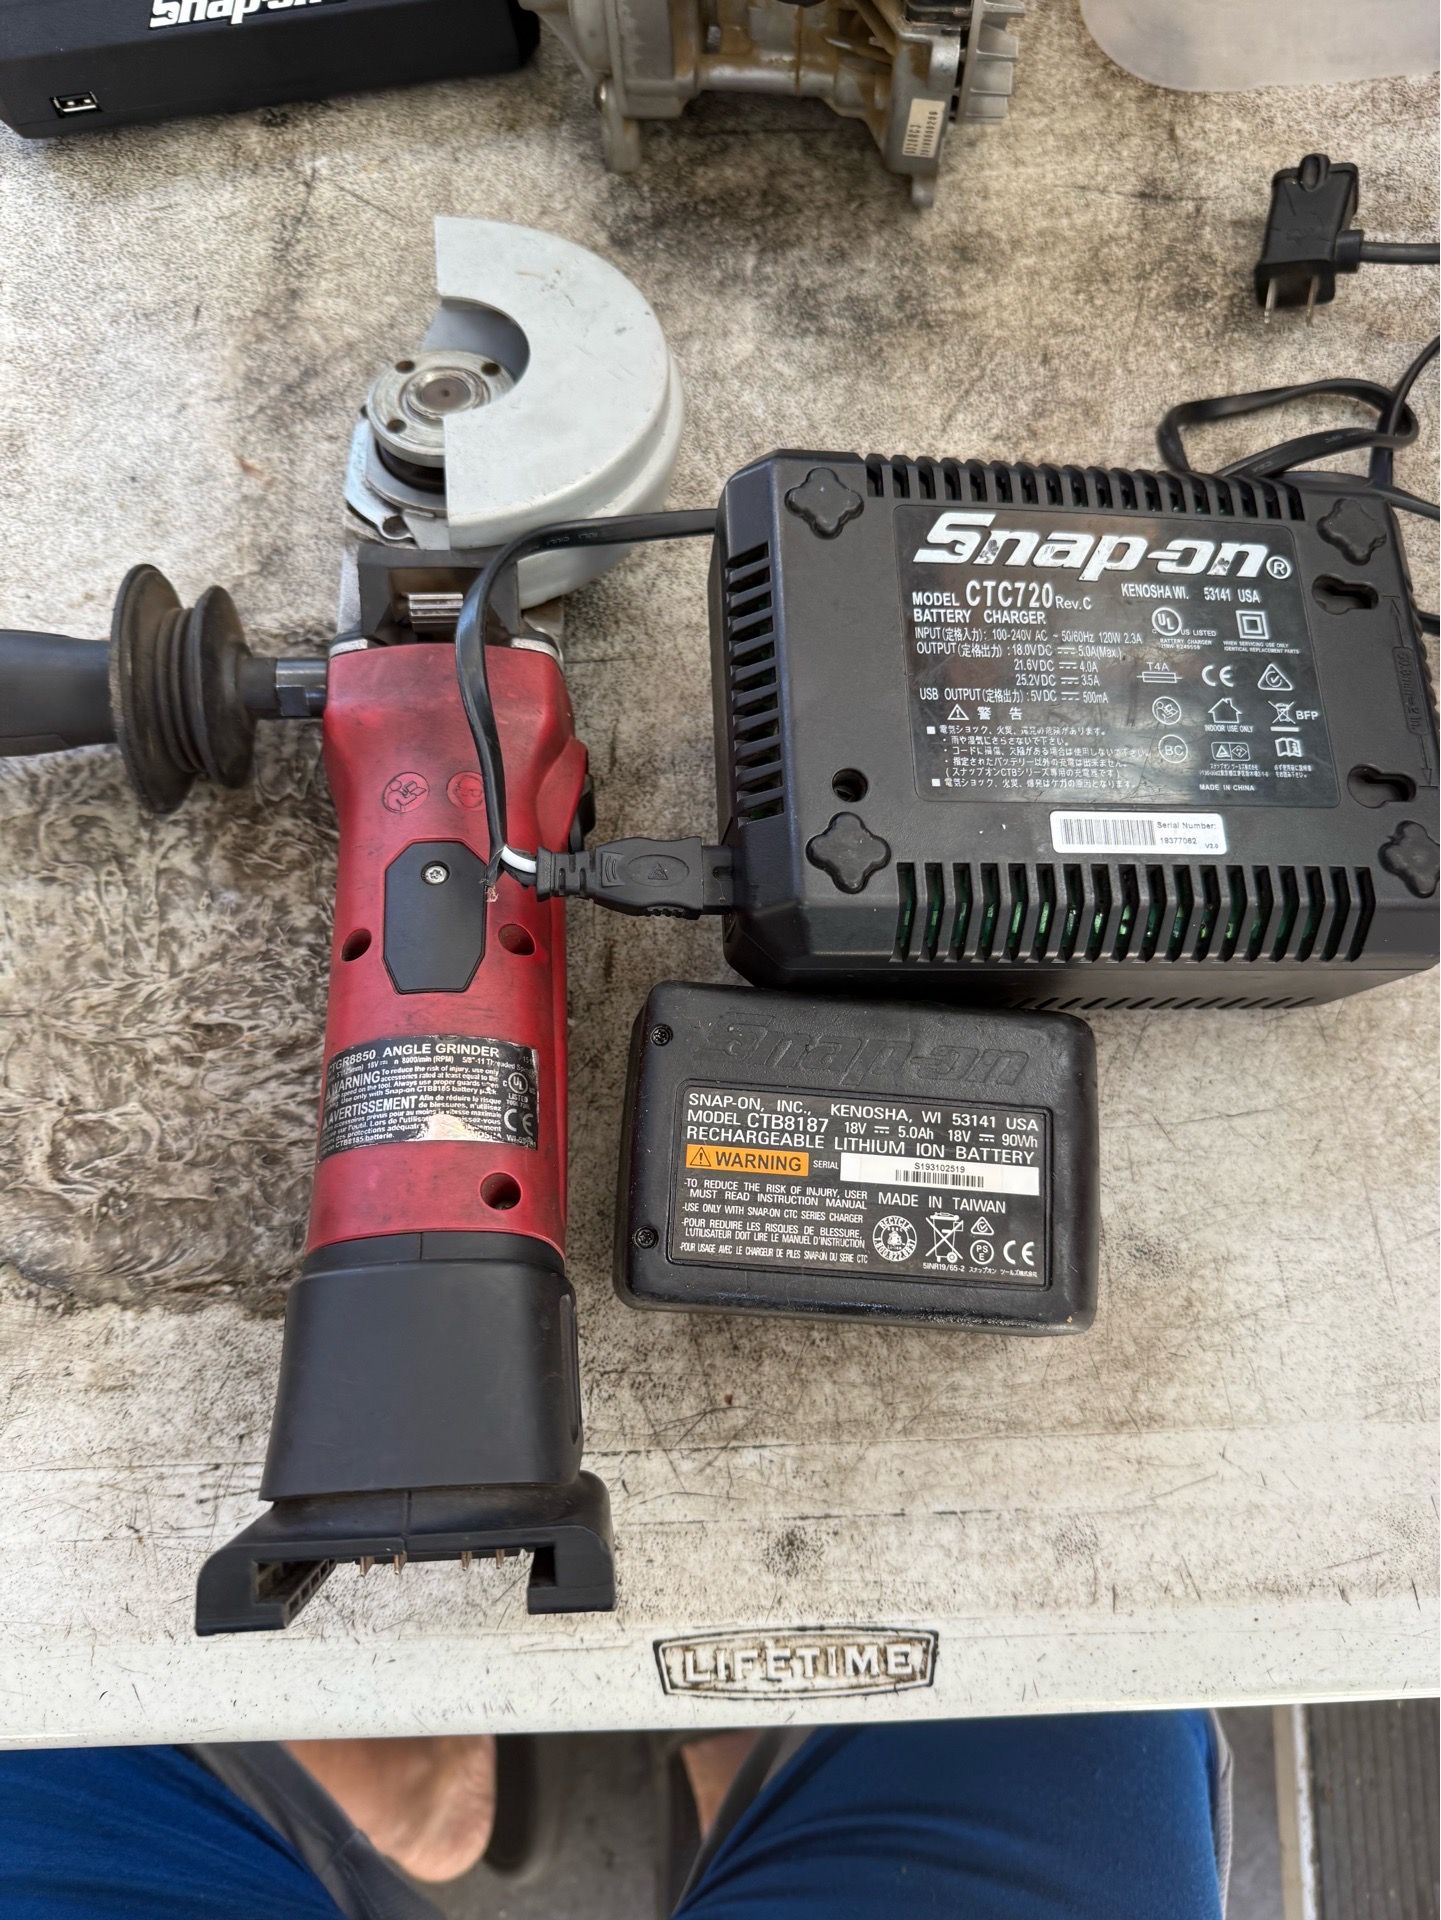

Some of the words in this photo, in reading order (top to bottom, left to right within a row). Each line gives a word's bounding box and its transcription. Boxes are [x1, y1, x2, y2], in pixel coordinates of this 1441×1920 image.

[912, 591, 960, 606] MODEL
[965, 579, 1053, 608] CTC720
[1055, 595, 1092, 610] Rev.C
[1121, 583, 1171, 599] KENOSHA
[1172, 587, 1189, 600] WI.
[1204, 587, 1231, 602] 53141
[1238, 588, 1260, 604] USA
[913, 608, 971, 624] BATTERY
[983, 610, 1047, 625] CHARGER
[992, 628, 1031, 641] 100-240V
[1035, 629, 1048, 641] AC
[1061, 629, 1094, 643] 50/60Hz
[1099, 631, 1121, 644] 120W
[1124, 631, 1142, 644] 2.3A
[1079, 660, 1098, 673] 4.0A
[1146, 662, 1169, 671] T4A
[1081, 675, 1100, 687] 3.5A
[920, 688, 939, 700] USB
[1083, 691, 1109, 704] 500mA
[1295, 710, 1319, 721] BFP
[1240, 725, 1253, 733] ONLY
[1164, 745, 1184, 756] BC
[383, 1043, 432, 1058] ANGLE
[435, 1043, 500, 1059] GRINDER
[391, 1066, 413, 1075] reduce
[384, 1087, 415, 1096] Snap-on
[452, 1086, 479, 1095] battery
[393, 1080, 418, 1088] Always
[328, 1095, 419, 1125] AVERTISSEMENT
[688, 1093, 765, 1112] SNAP-ON,
[776, 1099, 812, 1115] INC.,
[831, 1103, 912, 1123] KENOSHA,
[922, 1110, 941, 1124] WI
[952, 1113, 996, 1128] 53141
[1006, 1117, 1039, 1132] USA
[687, 1109, 741, 1126] MODEL
[747, 1112, 829, 1133] CTB8187
[844, 1122, 867, 1135] 18V
[898, 1125, 934, 1140] 5.0Ah
[948, 1129, 971, 1143] 18V
[1002, 1133, 1038, 1148] 90Wh
[686, 1125, 825, 1149] RECHARGEABLE
[834, 1137, 905, 1155] LITHIUM
[916, 1142, 945, 1158] ION
[956, 1145, 1035, 1165] BATTERY
[715, 1151, 801, 1172] WARNING
[813, 1159, 840, 1170] SERIAL
[914, 1162, 966, 1173] S193102519
[704, 1179, 739, 1191] REDUCE
[743, 1182, 761, 1192] THE
[766, 1183, 787, 1194] RISK
[790, 1185, 802, 1195] OF
[844, 1189, 868, 1200] USER
[689, 1188, 718, 1199] MUST
[724, 1191, 750, 1201] READ
[757, 1193, 819, 1206] INSTRUCTION
[825, 1198, 868, 1210] MANUAL
[878, 1191, 919, 1207] MADE
[928, 1195, 943, 1209] IN
[952, 1197, 1007, 1213] TAIWAN
[702, 1203, 722, 1214] ONLY
[724, 1205, 745, 1215] WITH
[747, 1207, 781, 1218] SNAP-ON
[783, 1209, 798, 1219] CTC
[800, 1210, 826, 1221] SERIES
[829, 1212, 864, 1223] CHARGER
[709, 1219, 743, 1230] REDUIRE
[746, 1221, 761, 1231] LES
[765, 1223, 799, 1234] RISQUES
[803, 1226, 814, 1236] DE
[685, 1227, 732, 1240] L'UTILISATEUR
[735, 1230, 751, 1240] DOIT
[753, 1232, 768, 1242] LIRE
[771, 1233, 779, 1243] LE
[782, 1234, 811, 1245] MANUEL
[813, 1236, 866, 1249] D'INSTRUCTION
[697, 1243, 716, 1253] USAGE
[718, 1245, 733, 1255] AVEC
[736, 1246, 743, 1255] LE
[745, 1246, 774, 1257] CHARGEUR
[776, 1248, 784, 1258] DE
[786, 1249, 801, 1259] PILES
[803, 1250, 828, 1261] SNAP-ON
[829, 1252, 838, 1262] DU
[839, 1253, 854, 1262] SERIE
[856, 1254, 868, 1263] CTC
[683, 1643, 915, 1684] LIFETIME
